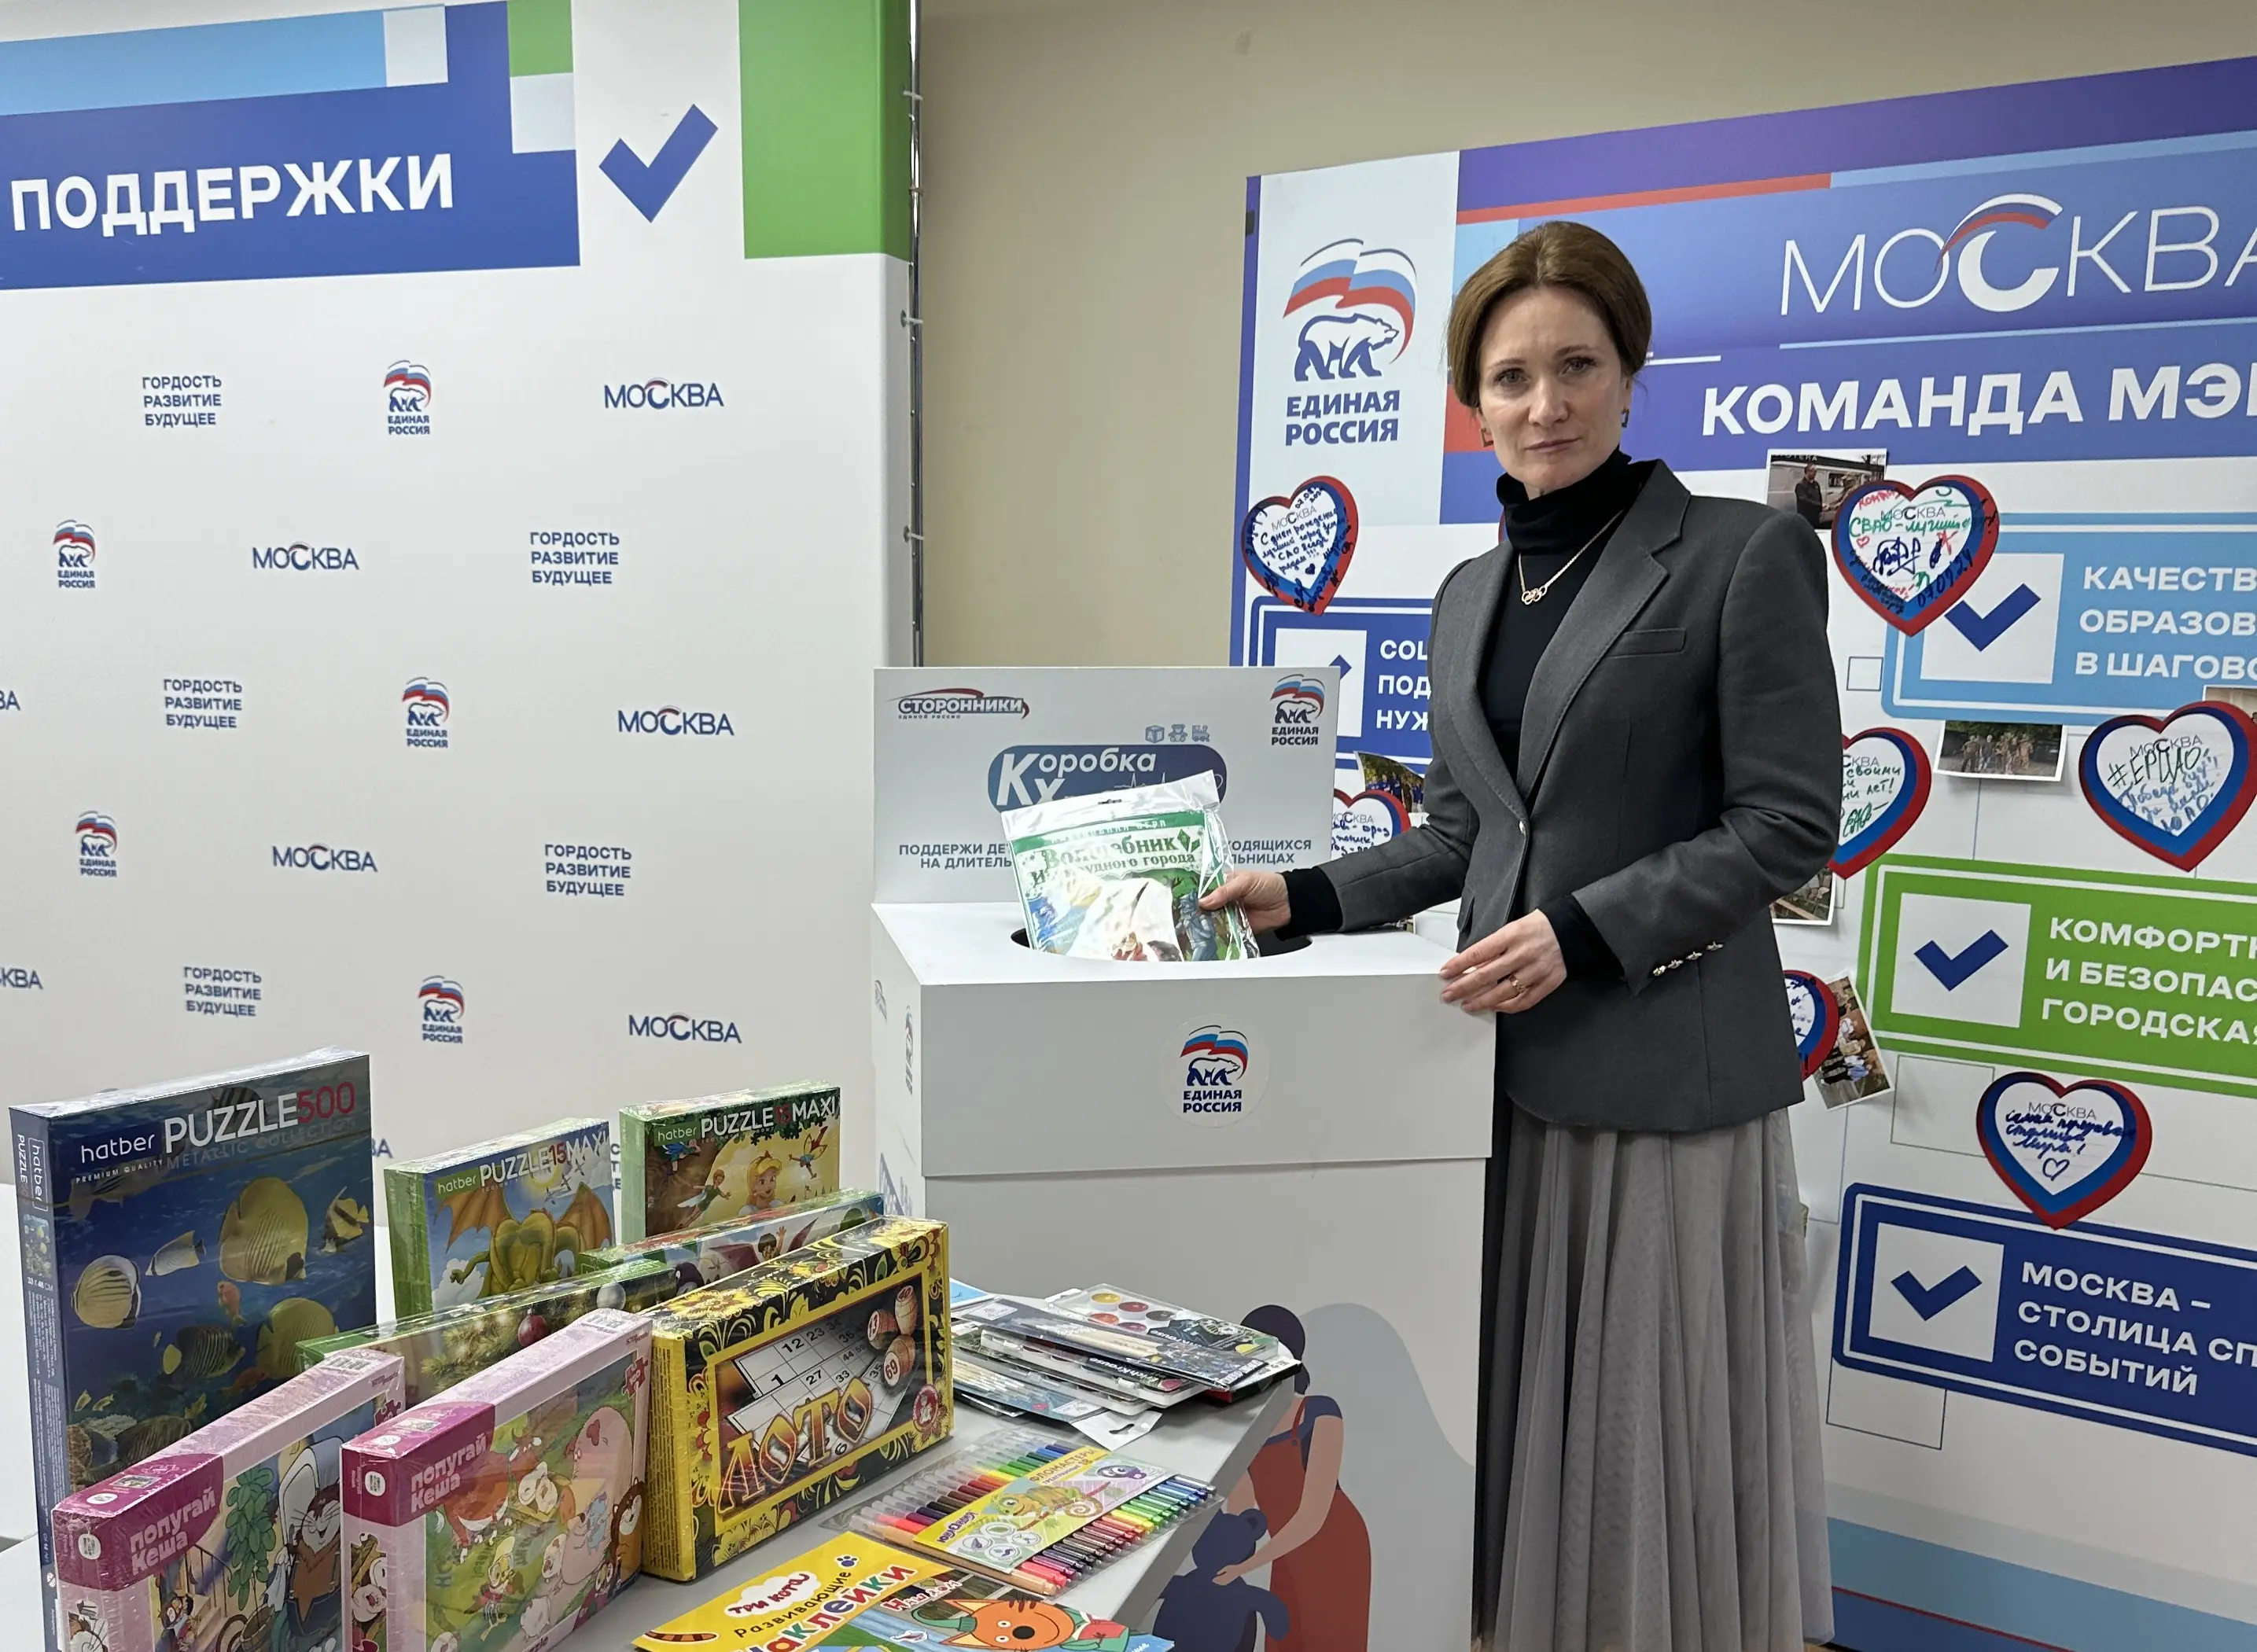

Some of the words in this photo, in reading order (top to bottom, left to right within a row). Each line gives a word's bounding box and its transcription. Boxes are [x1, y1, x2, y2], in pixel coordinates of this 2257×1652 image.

[10, 153, 454, 237] ПОДДЕРЖКИ
[142, 375, 222, 390] ГОРДОСТЬ
[144, 394, 221, 407] РАЗВИТИЕ
[605, 381, 724, 409] МОСКВА
[1703, 370, 2084, 436] КОМАНДА
[1287, 390, 1400, 419] ЕДИНАЯ
[145, 413, 215, 428] БУДУЩЕЕ
[388, 415, 430, 425] ЕДИНАЯ
[388, 425, 430, 436] РОССИЯ
[1284, 418, 1399, 447] РОССИЯ
[1271, 506, 1317, 532] МОСКВА
[531, 532, 619, 547] ГОРДОСТЬ
[252, 544, 359, 570] МОСКВА
[532, 551, 618, 565] РАЗВИТИЕ
[57, 570, 95, 579] ЕДИНАЯ
[532, 571, 612, 587] БУДУЩЕЕ
[2083, 566, 2257, 592] КАЧЕСТВ
[58, 579, 95, 588] РОССИЯ
[2079, 609, 2256, 636] ОБРАЗОВ
[2075, 652, 2099, 676] В
[164, 679, 242, 694] ГОРДОСТЬ
[1378, 675, 1431, 700] ПОД
[165, 697, 242, 711] РАЗВИТИЕ
[898, 698, 1025, 714] СТОРОННИКИ
[167, 714, 237, 730] БУДУЩЕЕ
[618, 708, 734, 735] МОСКВА
[407, 729, 447, 738] ЕДИНАЯ
[1272, 727, 1320, 736] ЕДИНАЯ
[407, 738, 448, 748] РОССИЯ
[1271, 737, 1319, 745] РОССИЯ
[996, 748, 1156, 807] Коробка
[545, 844, 631, 860] ГОРДОСТЬ
[899, 844, 983, 855] ПОДДЕРЖИ
[987, 844, 1007, 855] ДЕ
[79, 859, 116, 867] ЕДИНАЯ
[273, 845, 377, 872] МОСКВА
[921, 858, 940, 868] НА
[944, 858, 1012, 870] ДЛИТЕЛЬ
[1143, 853, 1195, 866] города
[80, 868, 117, 877] РОССИЯ
[546, 863, 631, 878] РАЗВИТИЕ
[547, 881, 624, 897] БУДУЩЕЕ
[0, 967, 43, 990] КВА
[184, 966, 261, 983] ГОРДОСТЬ
[2046, 958, 2068, 981] И
[2079, 962, 2257, 1003] БЕЗОПАС
[185, 984, 261, 1000] РАЗВИТИЕ
[186, 1000, 256, 1017] БУДУЩЕЕ
[422, 1025, 462, 1034] ЕДИНАЯ
[629, 1015, 742, 1043] МОСКВА
[2042, 999, 2257, 1045] ГОРОДСКА
[423, 1034, 462, 1043] РОССИЯ
[1183, 1089, 1243, 1102] ЕДИНАЯ
[1183, 1102, 1242, 1113] РОССИЯ
[2028, 1102, 2097, 1119] МОСКВА
[657, 1126, 697, 1142] hatber
[81, 1134, 156, 1164] hatber
[167, 1143, 249, 1170] METALLIC
[32, 1144, 43, 1202] hatber
[75, 1168, 120, 1183] PREMIUM
[123, 1159, 165, 1173] QUALITY
[437, 1175, 477, 1194] hatber
[2022, 1261, 2181, 1312] МОСКВА
[781, 1338, 805, 1354] 12
[806, 1327, 826, 1341] 23
[2017, 1301, 2198, 1356] СТОЛИЦА
[2208, 1339, 2257, 1368] СП
[885, 1359, 898, 1380] 69
[2014, 1339, 2198, 1396] СОБЫТИЙ
[805, 1369, 823, 1385] 27
[716, 1378, 872, 1513] ЛОТО
[734, 1571, 852, 1639] развивающие
